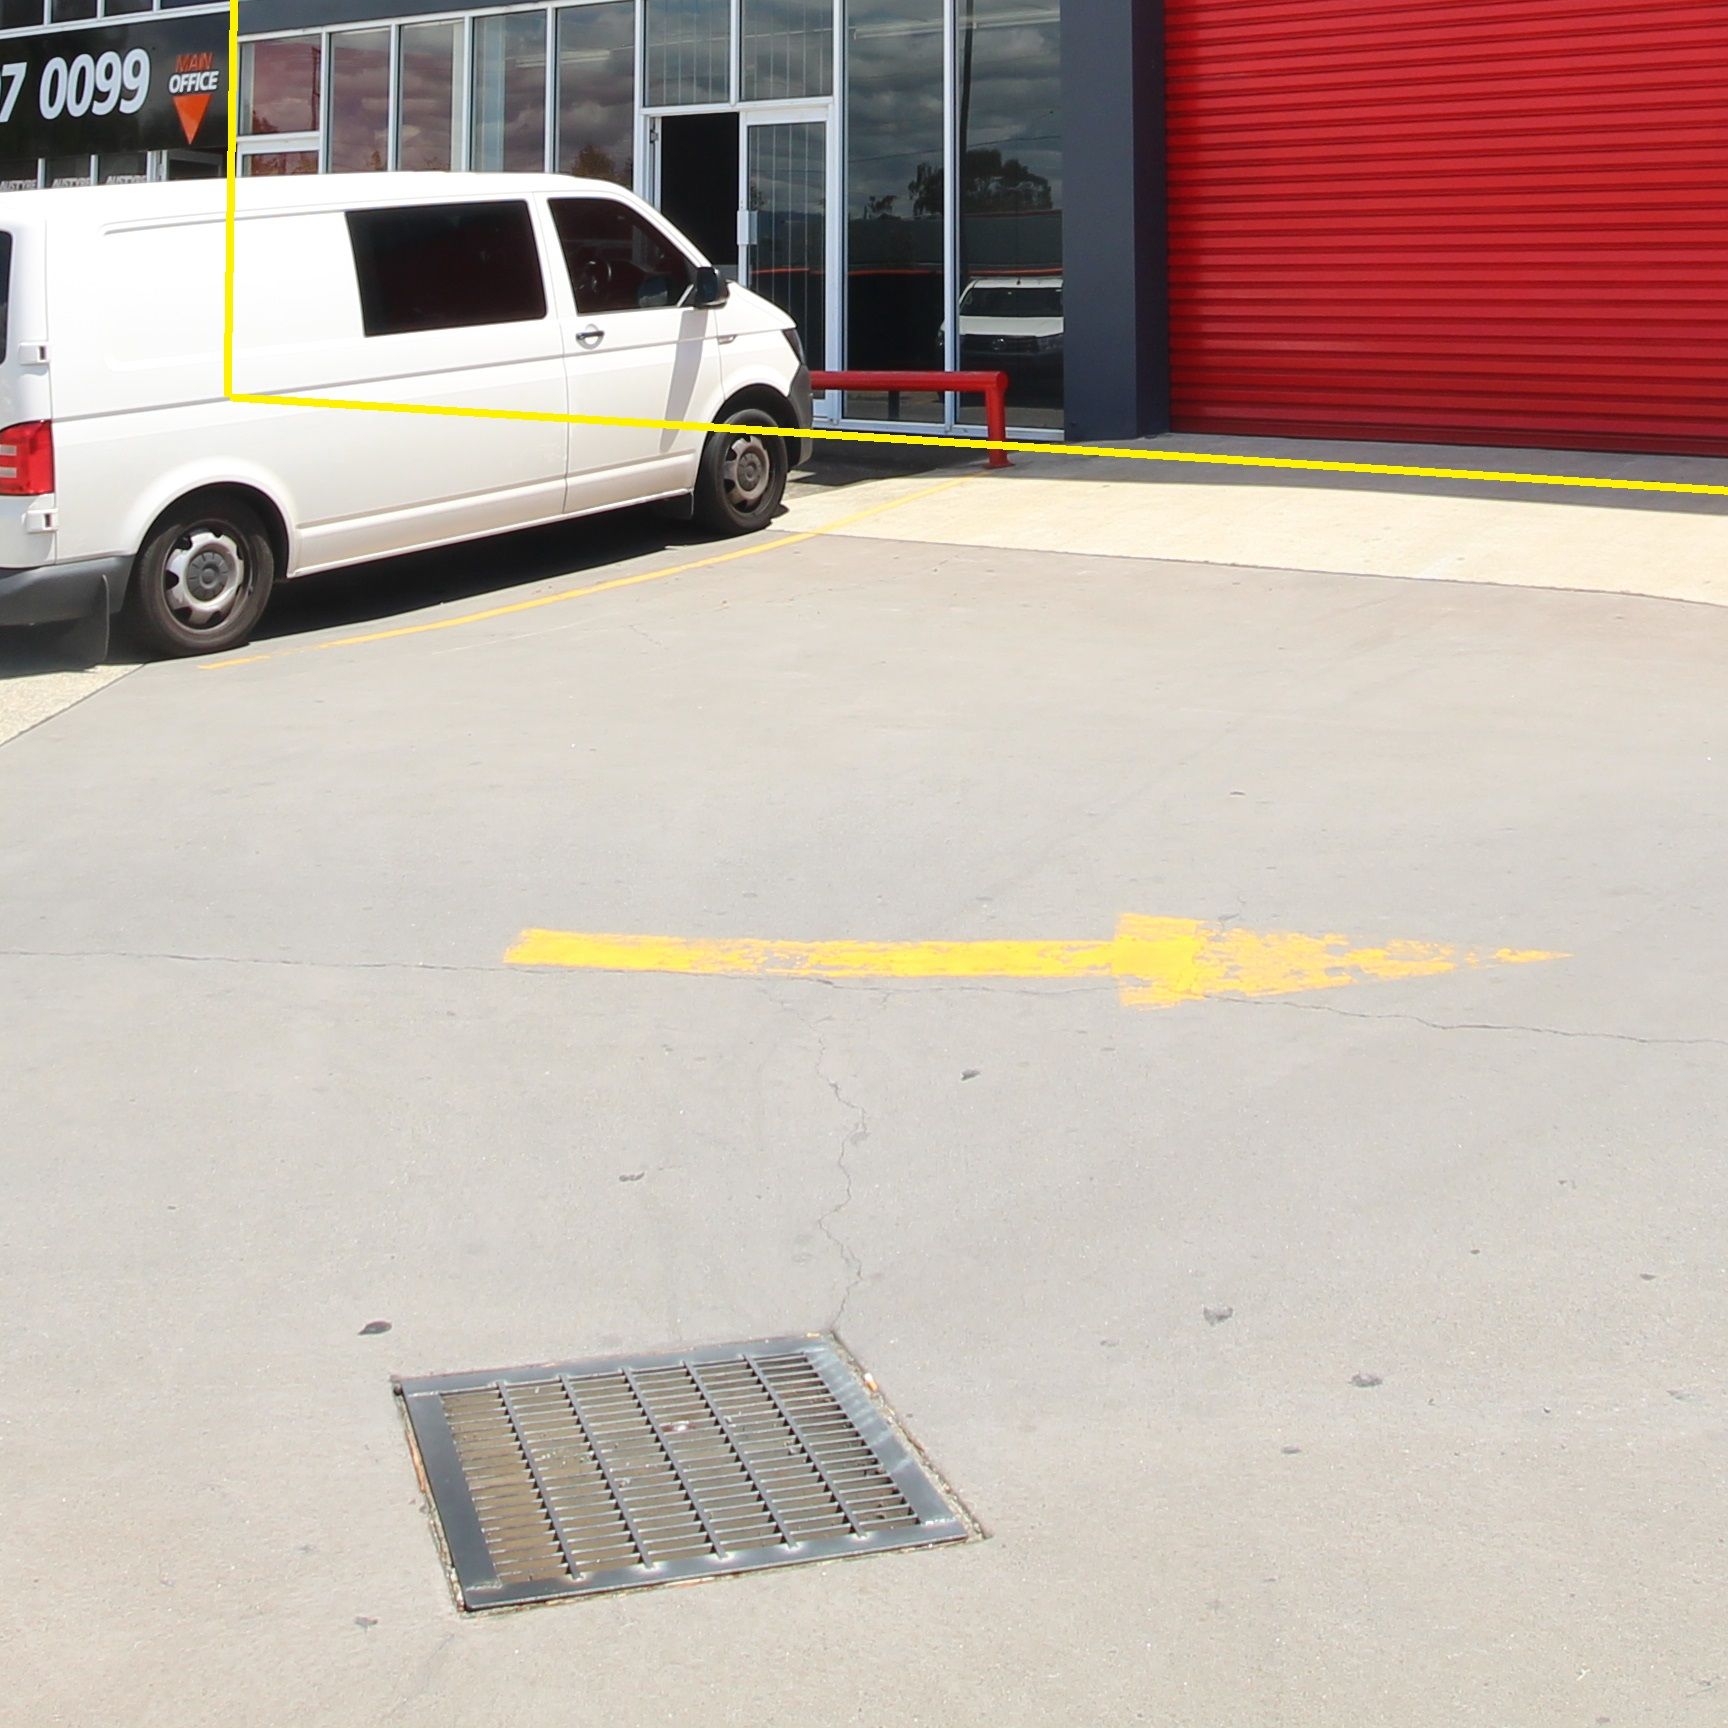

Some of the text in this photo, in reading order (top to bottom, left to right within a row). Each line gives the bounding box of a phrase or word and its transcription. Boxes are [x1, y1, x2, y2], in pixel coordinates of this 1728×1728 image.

[175, 52, 213, 71] MAIN
[38, 48, 151, 120] 0099
[168, 71, 220, 93] OFFICE
